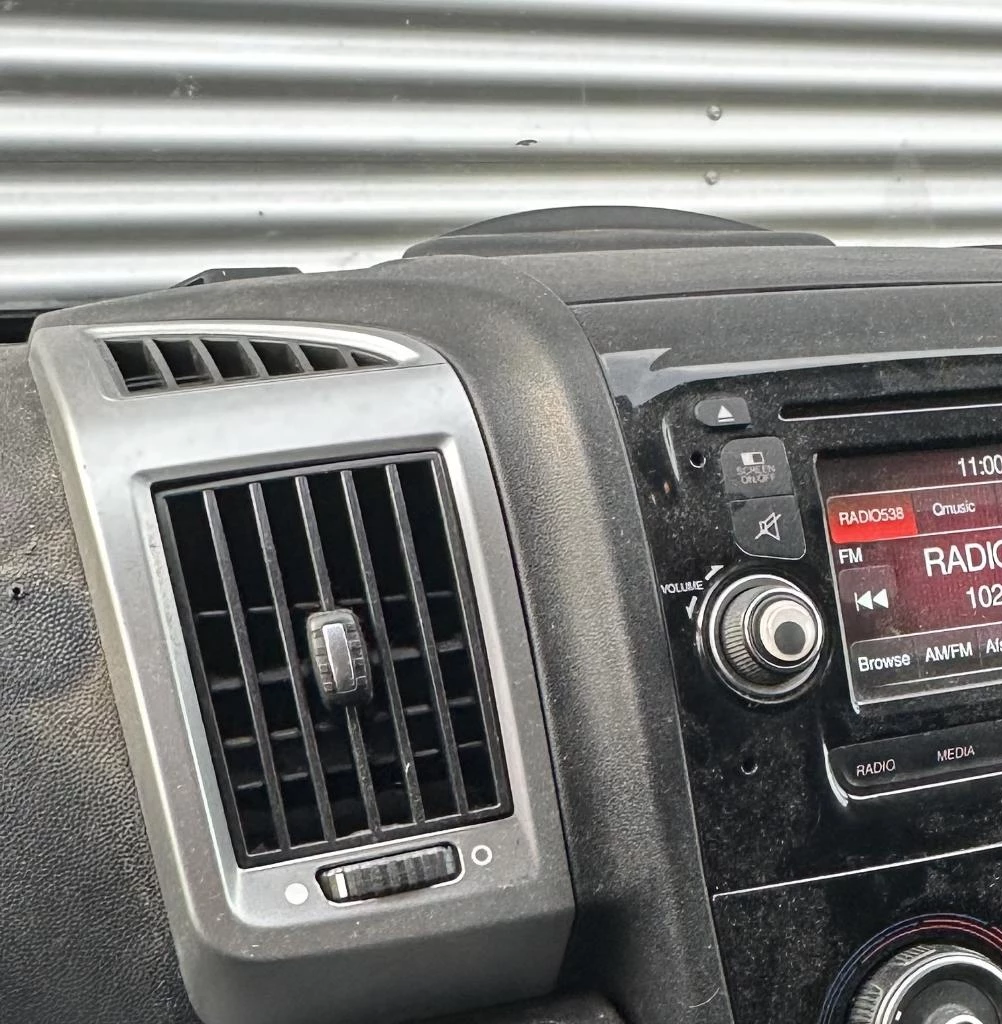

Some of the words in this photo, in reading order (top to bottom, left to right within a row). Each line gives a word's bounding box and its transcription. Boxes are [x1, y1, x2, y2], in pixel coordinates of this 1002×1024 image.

[736, 465, 776, 476] SCREEN
[838, 507, 905, 526] RADIO538
[932, 500, 976, 517] Qmusic
[838, 547, 863, 564] FM
[661, 580, 704, 595] VOLUME
[925, 642, 974, 663] AM/FM
[857, 653, 912, 673] Browse
[937, 745, 976, 762] MEDIA
[856, 759, 896, 777] RADIO
